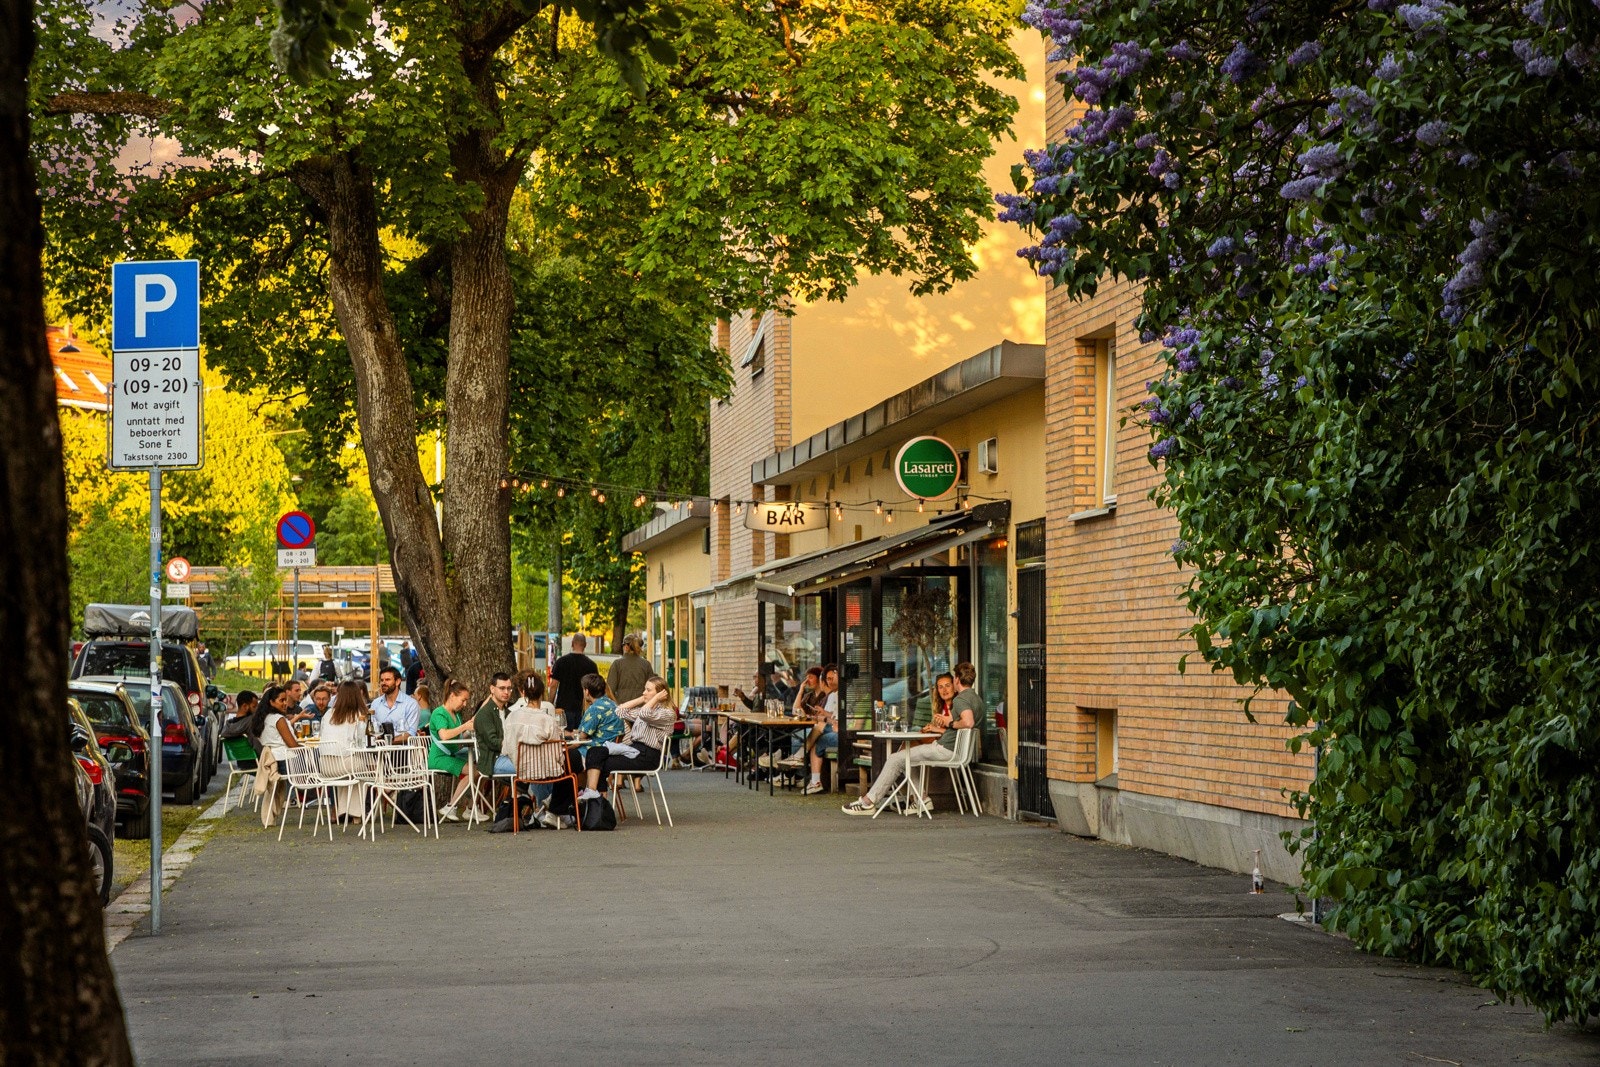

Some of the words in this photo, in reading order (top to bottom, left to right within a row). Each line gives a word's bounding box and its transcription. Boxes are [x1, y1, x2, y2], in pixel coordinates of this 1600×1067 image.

[135, 273, 177, 338] P
[131, 401, 148, 410] Mot
[153, 400, 180, 411] avgift
[126, 417, 160, 426] unntatt
[165, 416, 185, 425] med
[130, 428, 181, 437] beboerkort
[139, 440, 162, 448] Sone
[166, 439, 172, 448] E
[123, 453, 163, 461] Takstsone
[904, 461, 954, 474] Lasarett
[766, 510, 805, 526] BAR
